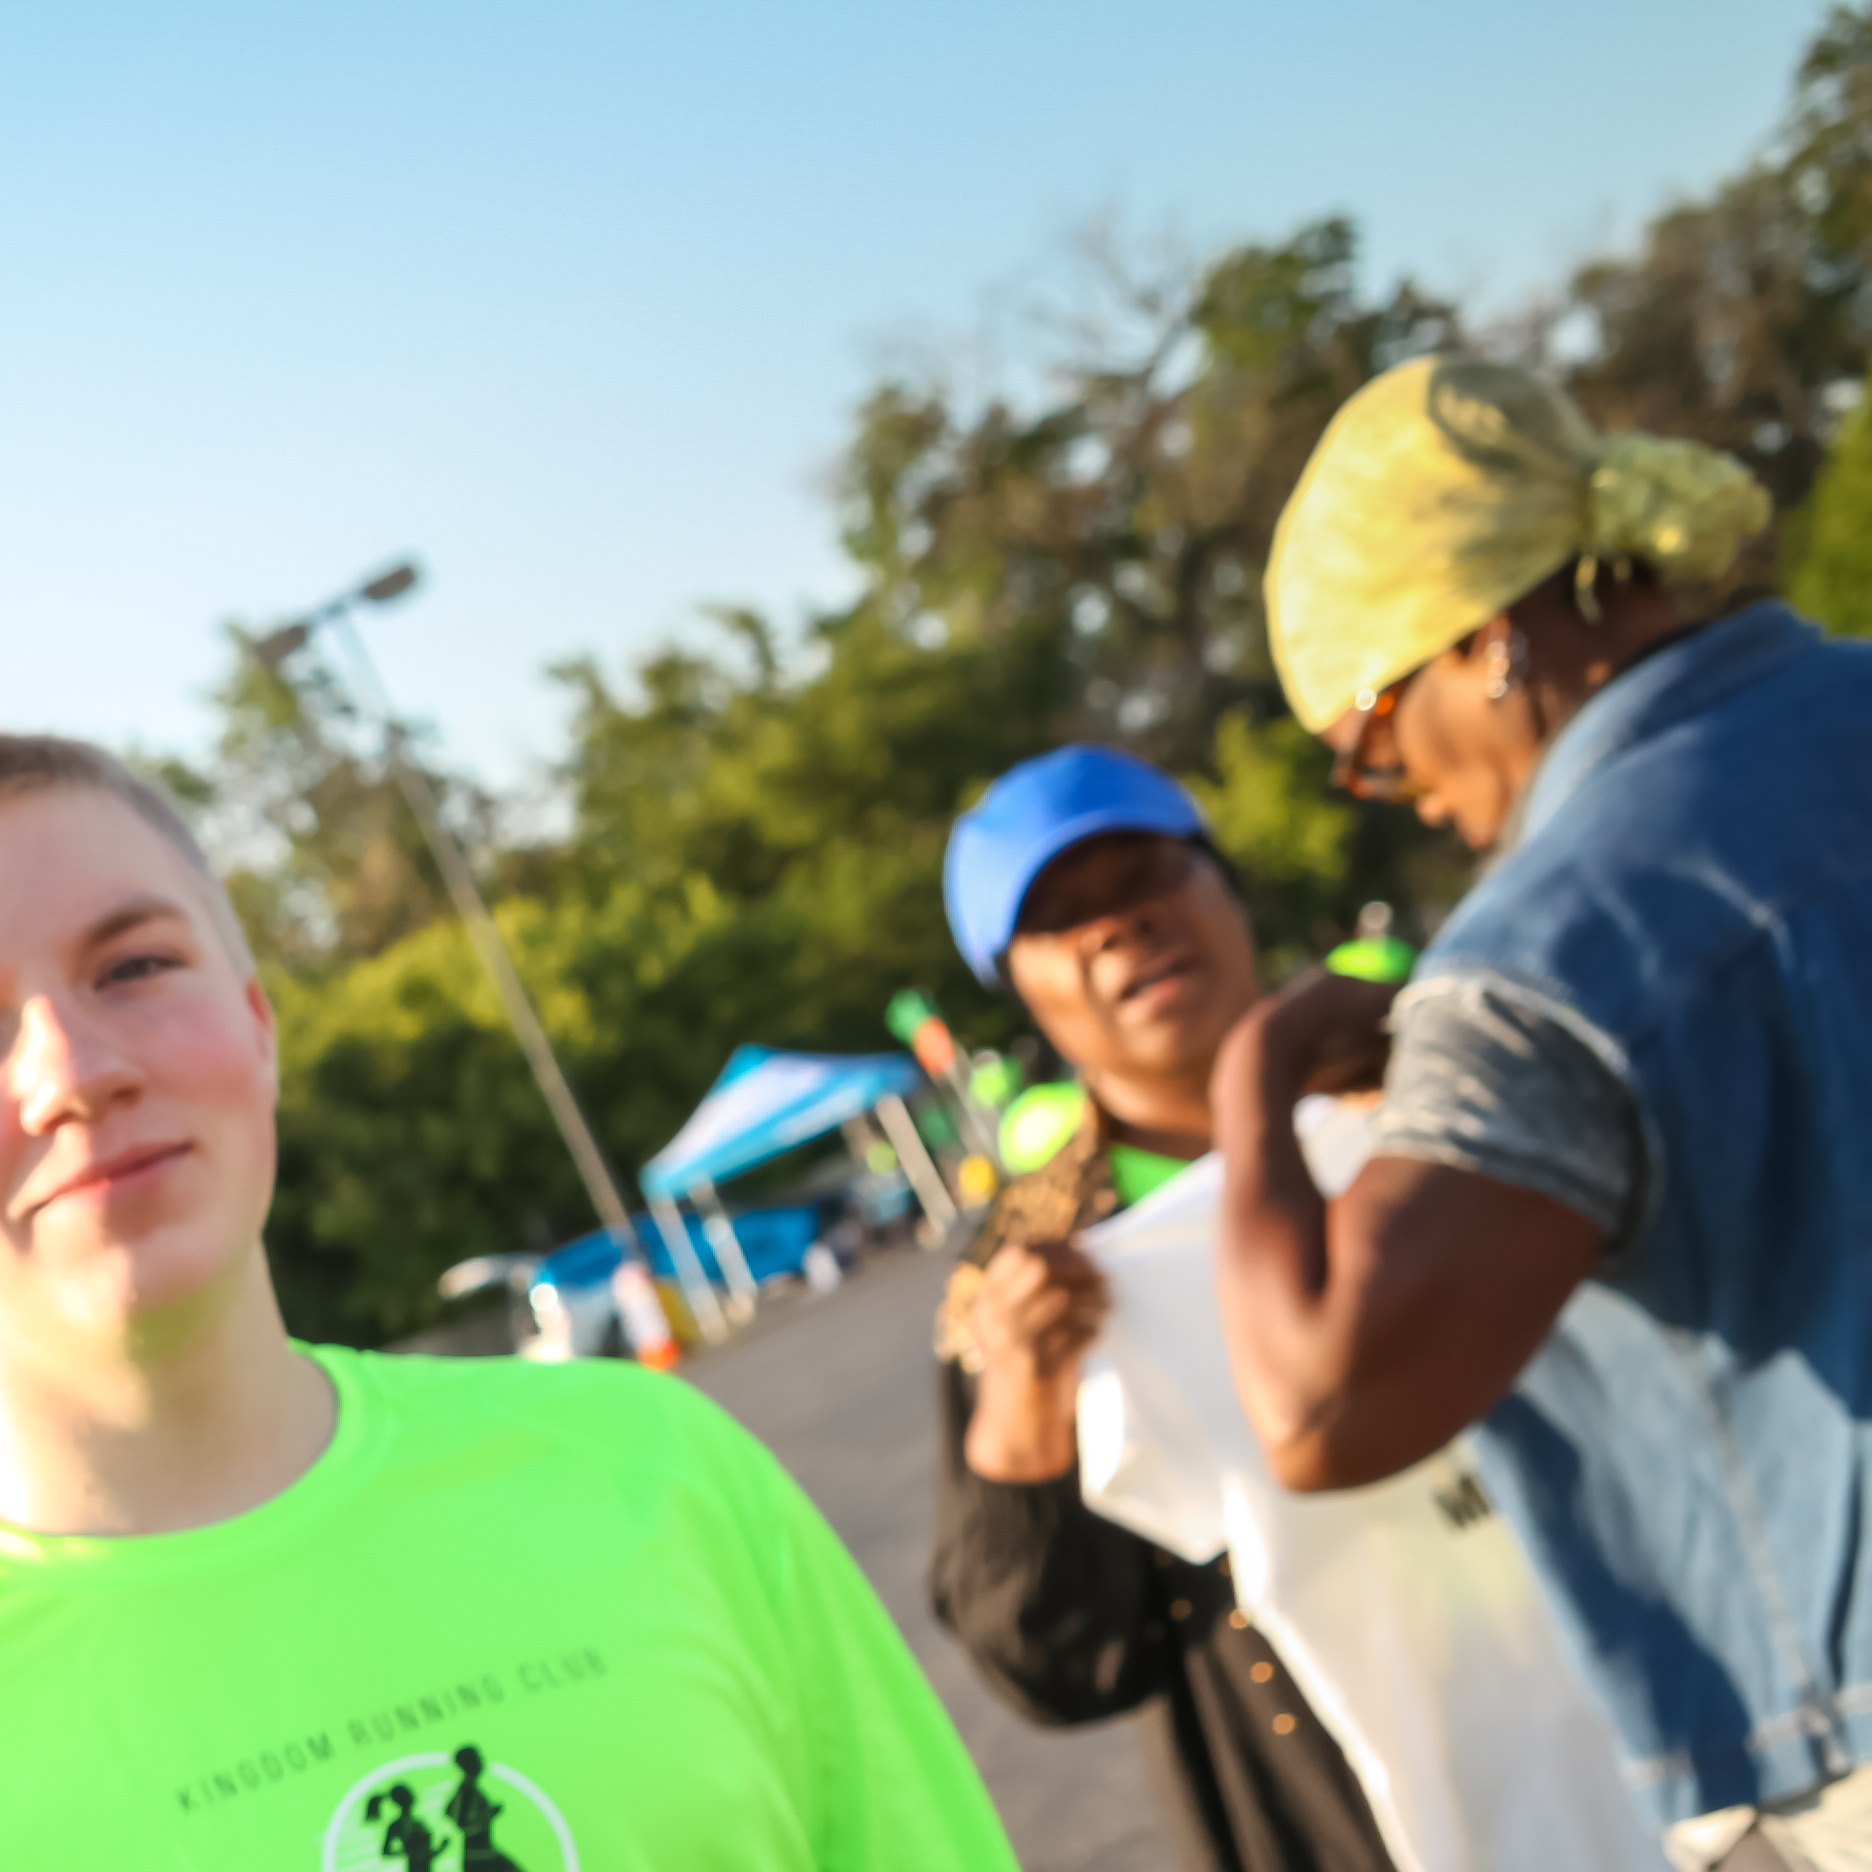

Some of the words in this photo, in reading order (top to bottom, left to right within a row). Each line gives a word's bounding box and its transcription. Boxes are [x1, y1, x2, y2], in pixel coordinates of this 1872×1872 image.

[176, 1732, 335, 1813] KINGDOM
[346, 1673, 505, 1746] RUNNING
[517, 1648, 608, 1693] CLUB
